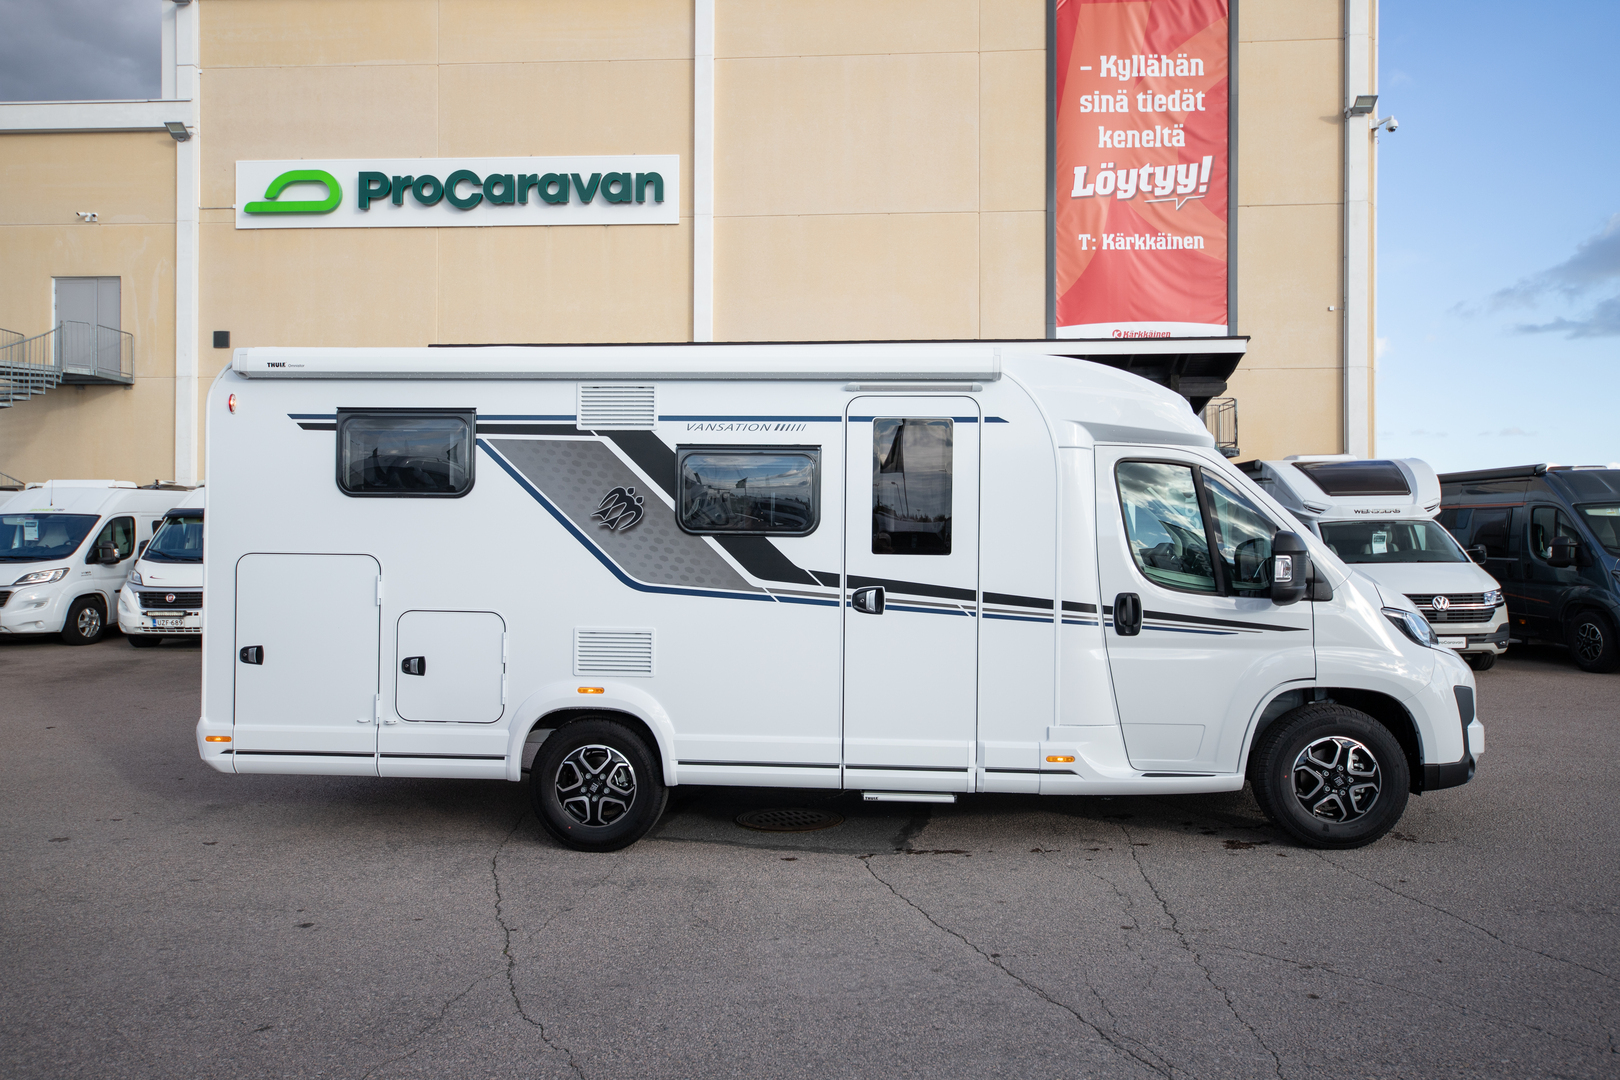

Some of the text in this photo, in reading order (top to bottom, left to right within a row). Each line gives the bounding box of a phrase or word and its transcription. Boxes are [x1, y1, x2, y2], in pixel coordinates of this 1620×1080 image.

[1099, 53, 1204, 81] Kyllähän
[1079, 88, 1206, 113] sinä tiedät
[1098, 124, 1186, 148] keneltä
[1071, 155, 1214, 200] Löytyy!
[358, 169, 665, 211] ProCaravan
[1078, 233, 1205, 251] T: Kärkkäinen
[1123, 330, 1171, 338] Kärkkäinen
[686, 423, 772, 432] VANSATION
